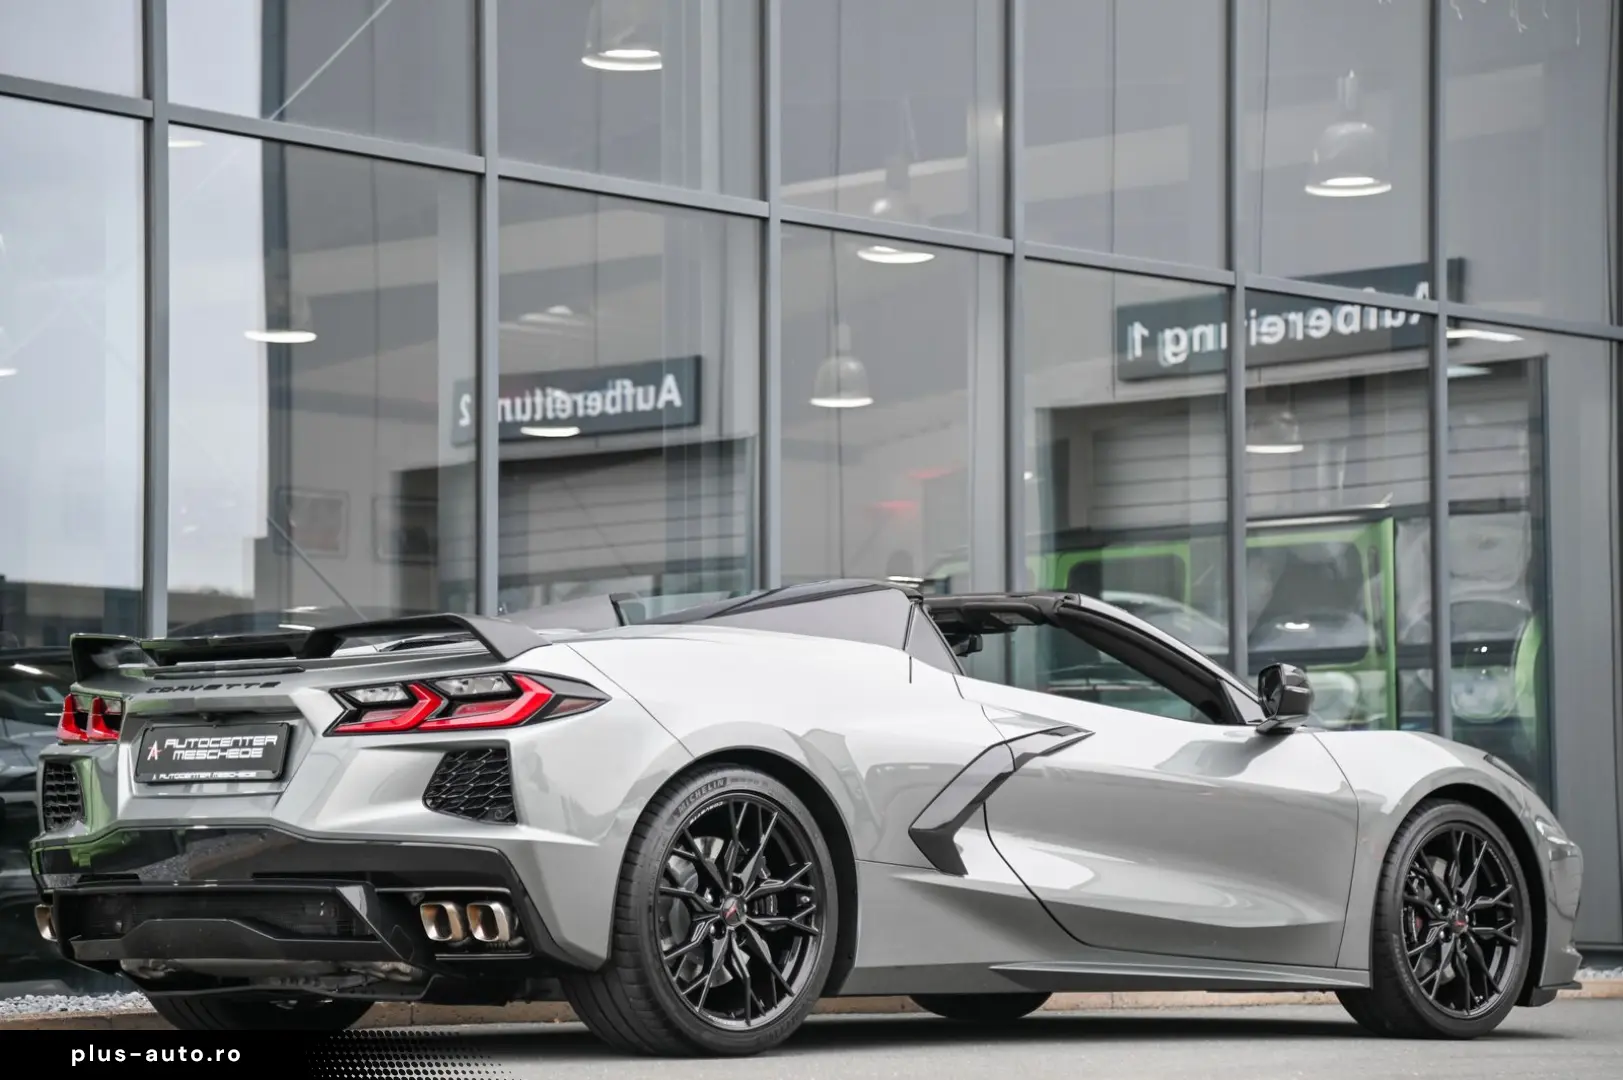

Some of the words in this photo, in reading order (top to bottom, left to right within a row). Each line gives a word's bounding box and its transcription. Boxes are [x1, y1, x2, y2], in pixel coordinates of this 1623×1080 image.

[146, 681, 281, 694] CORVETTE
[164, 735, 278, 749] AUTOCENTER
[172, 747, 264, 761] MESCHEDE
[159, 772, 211, 780] AUTOCENTER
[678, 778, 725, 814] MICHELIN
